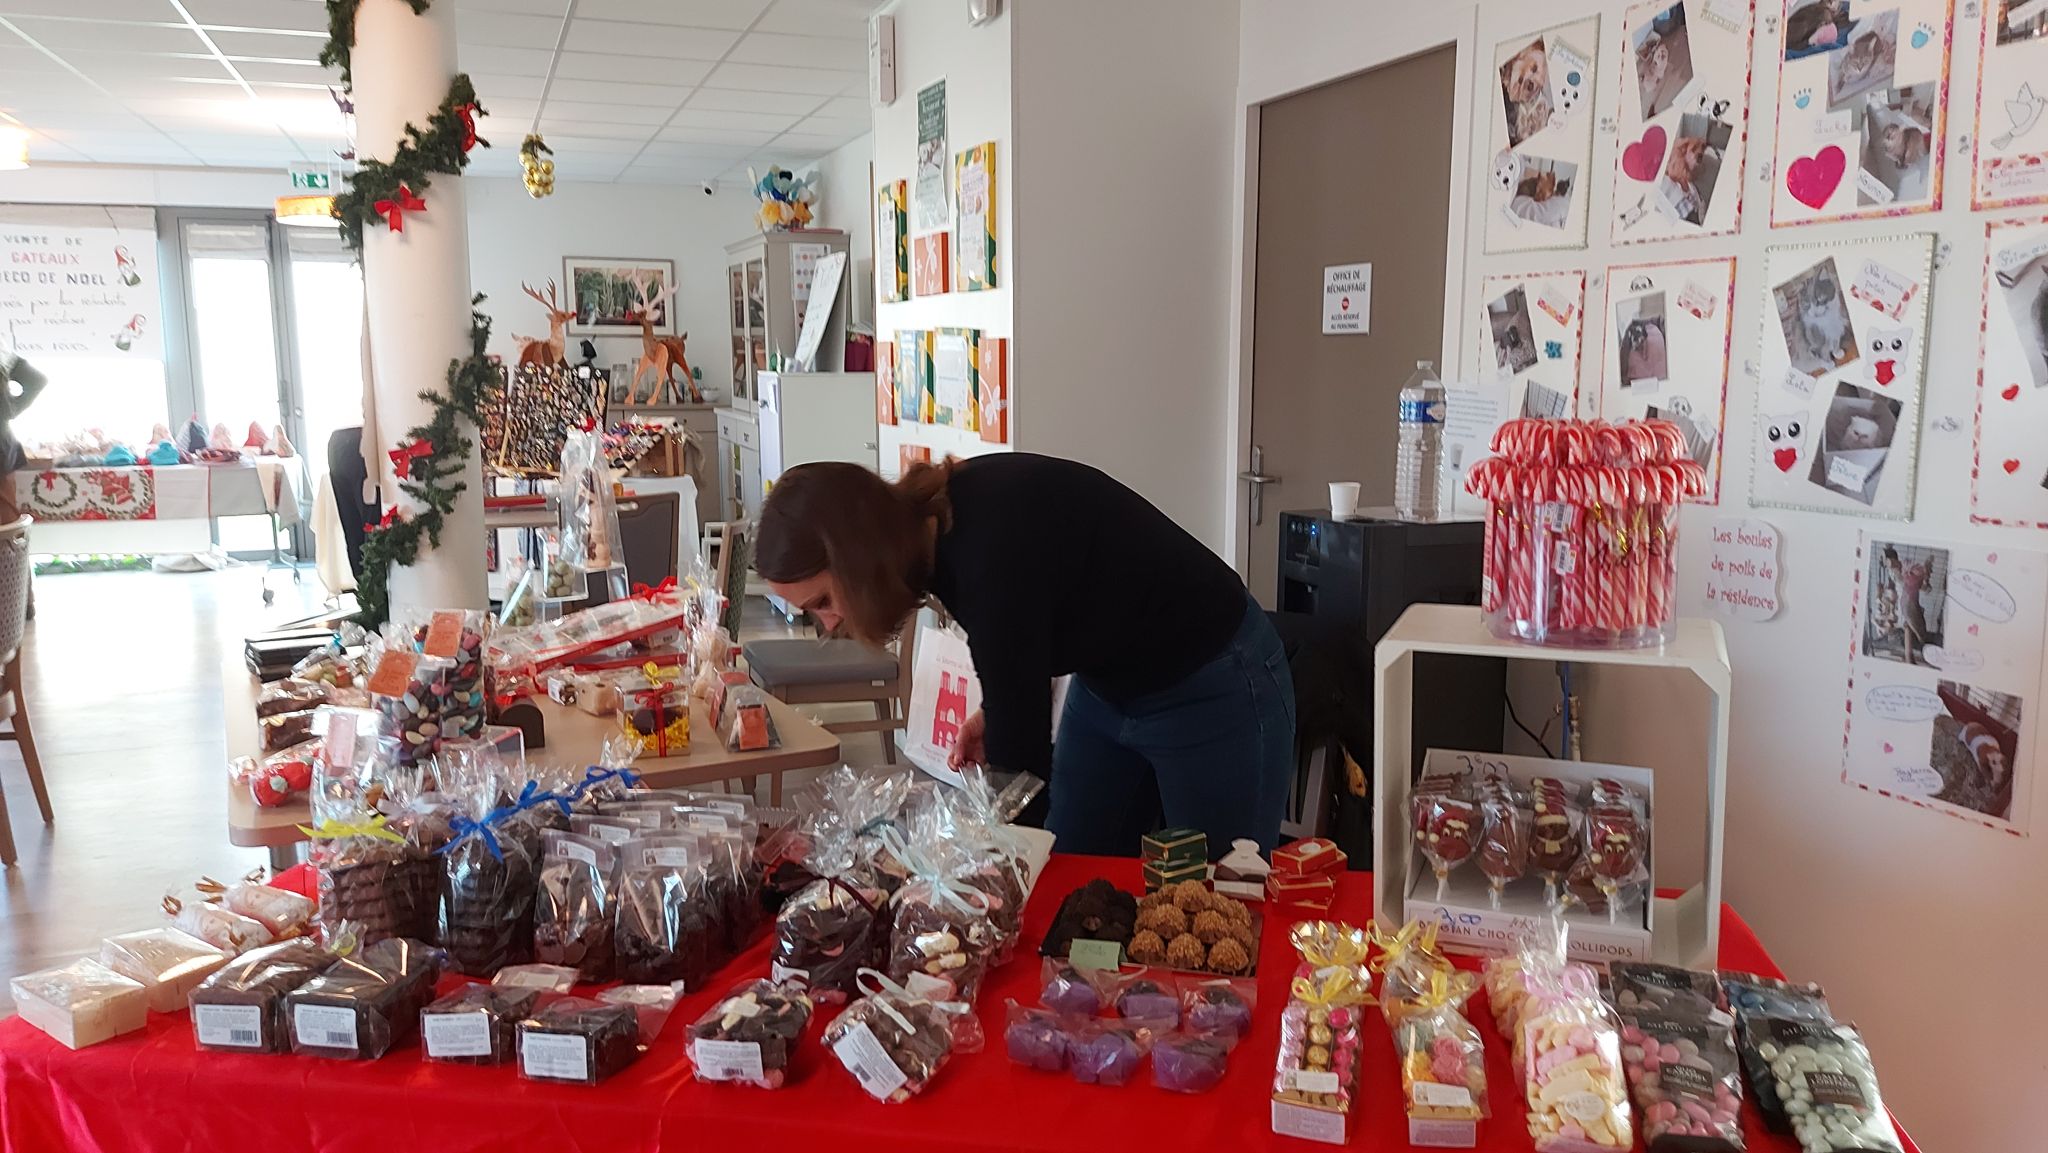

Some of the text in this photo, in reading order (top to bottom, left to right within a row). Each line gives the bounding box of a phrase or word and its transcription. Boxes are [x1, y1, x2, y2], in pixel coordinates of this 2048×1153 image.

[4, 235, 82, 246] VENTE DE
[0, 271, 31, 284] ECO
[38, 272, 56, 284] DE
[1332, 269, 1360, 281] OFFICE DE
[1326, 281, 1367, 294] RÉCHAUFFAGE
[1713, 526, 1773, 550] Les boules
[1711, 554, 1773, 580] de poils de
[1706, 582, 1774, 611] la résidence
[1418, 919, 1471, 936] BGIAN
[1568, 939, 1634, 957] OLLIPOPS
